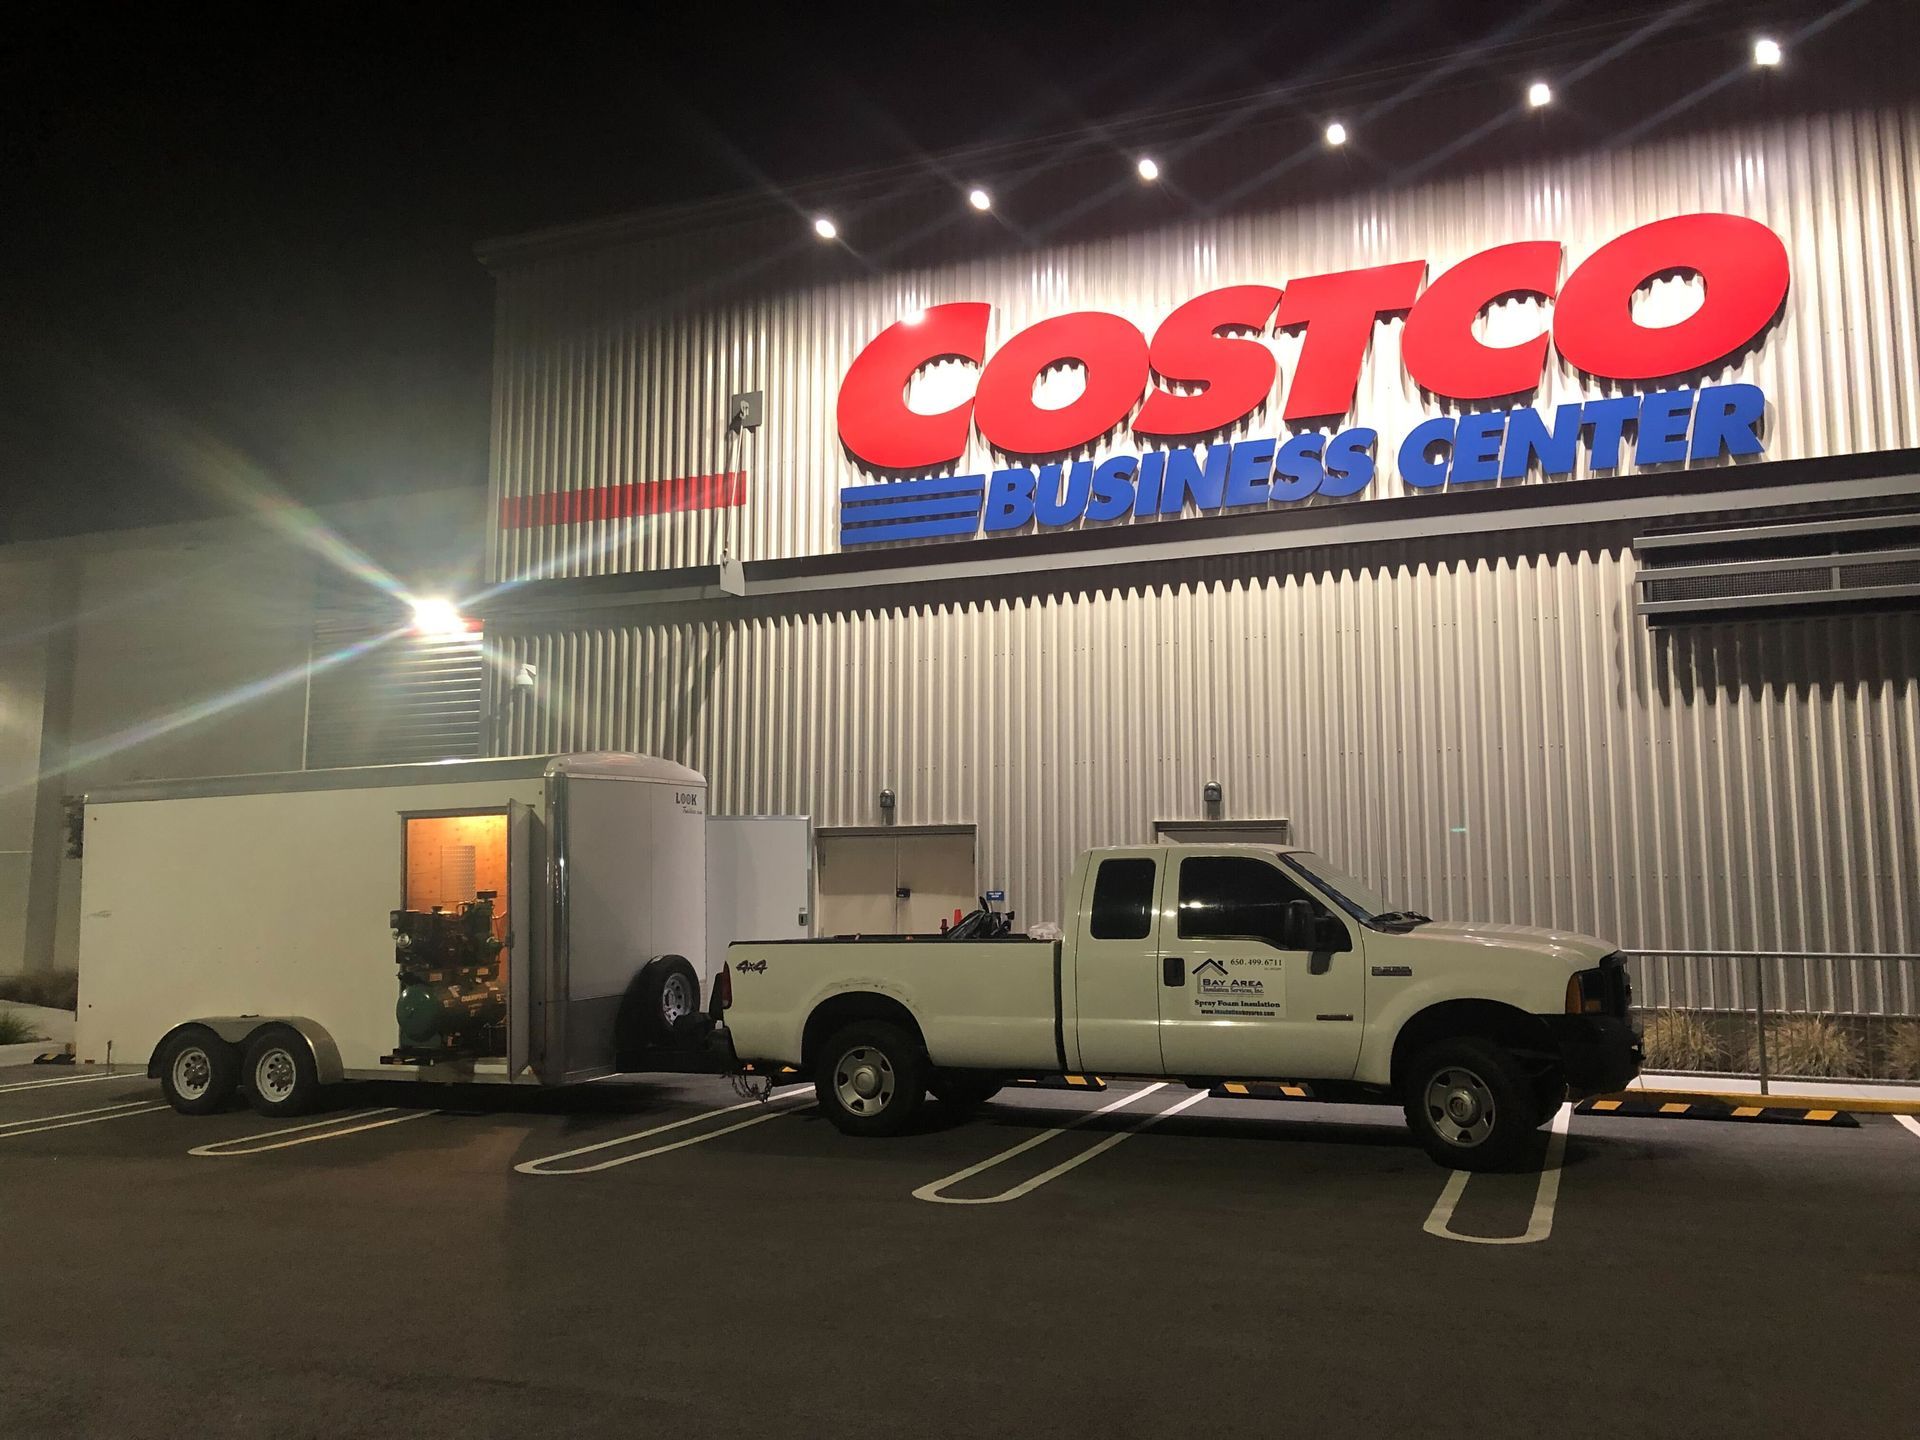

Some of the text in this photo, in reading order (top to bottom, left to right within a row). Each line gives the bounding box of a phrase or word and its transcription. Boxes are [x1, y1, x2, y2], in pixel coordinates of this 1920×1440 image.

[837, 212, 1790, 469] COSTCO
[984, 383, 1765, 532] BUSINESS CENTER
[675, 792, 697, 806] LOOK
[736, 959, 768, 975] 4x4
[1230, 958, 1282, 966] 650.499.6711
[1202, 978, 1263, 987] BAY AREA
[1194, 1000, 1216, 1008] Spray
